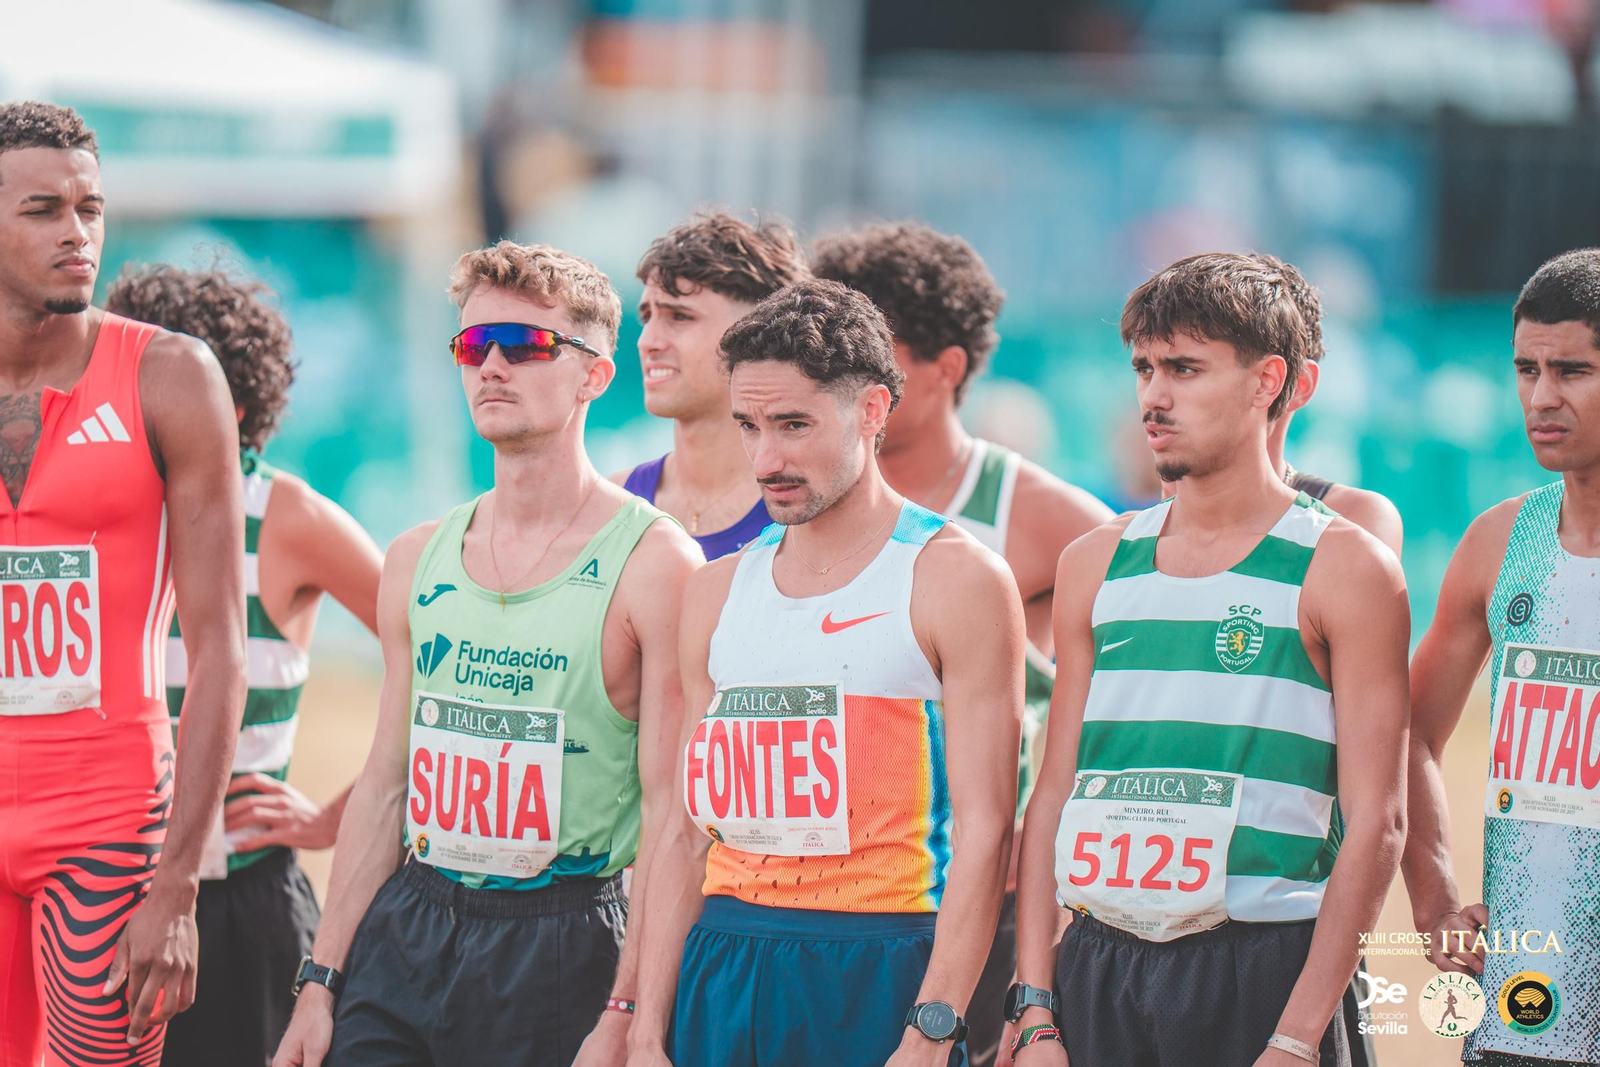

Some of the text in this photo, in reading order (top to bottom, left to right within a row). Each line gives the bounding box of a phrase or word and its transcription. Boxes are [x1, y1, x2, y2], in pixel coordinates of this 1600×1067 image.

[1228, 604, 1262, 616] SCP
[0, 581, 92, 678] ROS
[1222, 619, 1260, 635] SPORTING
[458, 640, 568, 672] Fundación
[1220, 653, 1253, 666] PORTUGAL
[455, 663, 534, 697] Unicaja
[725, 688, 791, 711] ITÁLICA
[447, 707, 511, 734] ITÁLICA
[688, 718, 839, 819] FONTES
[410, 742, 551, 841] SURÍA
[1112, 773, 1187, 797] ITÁLICA
[1124, 807, 1169, 816] MINEIRO, RUI
[1069, 832, 1213, 892] 5125
